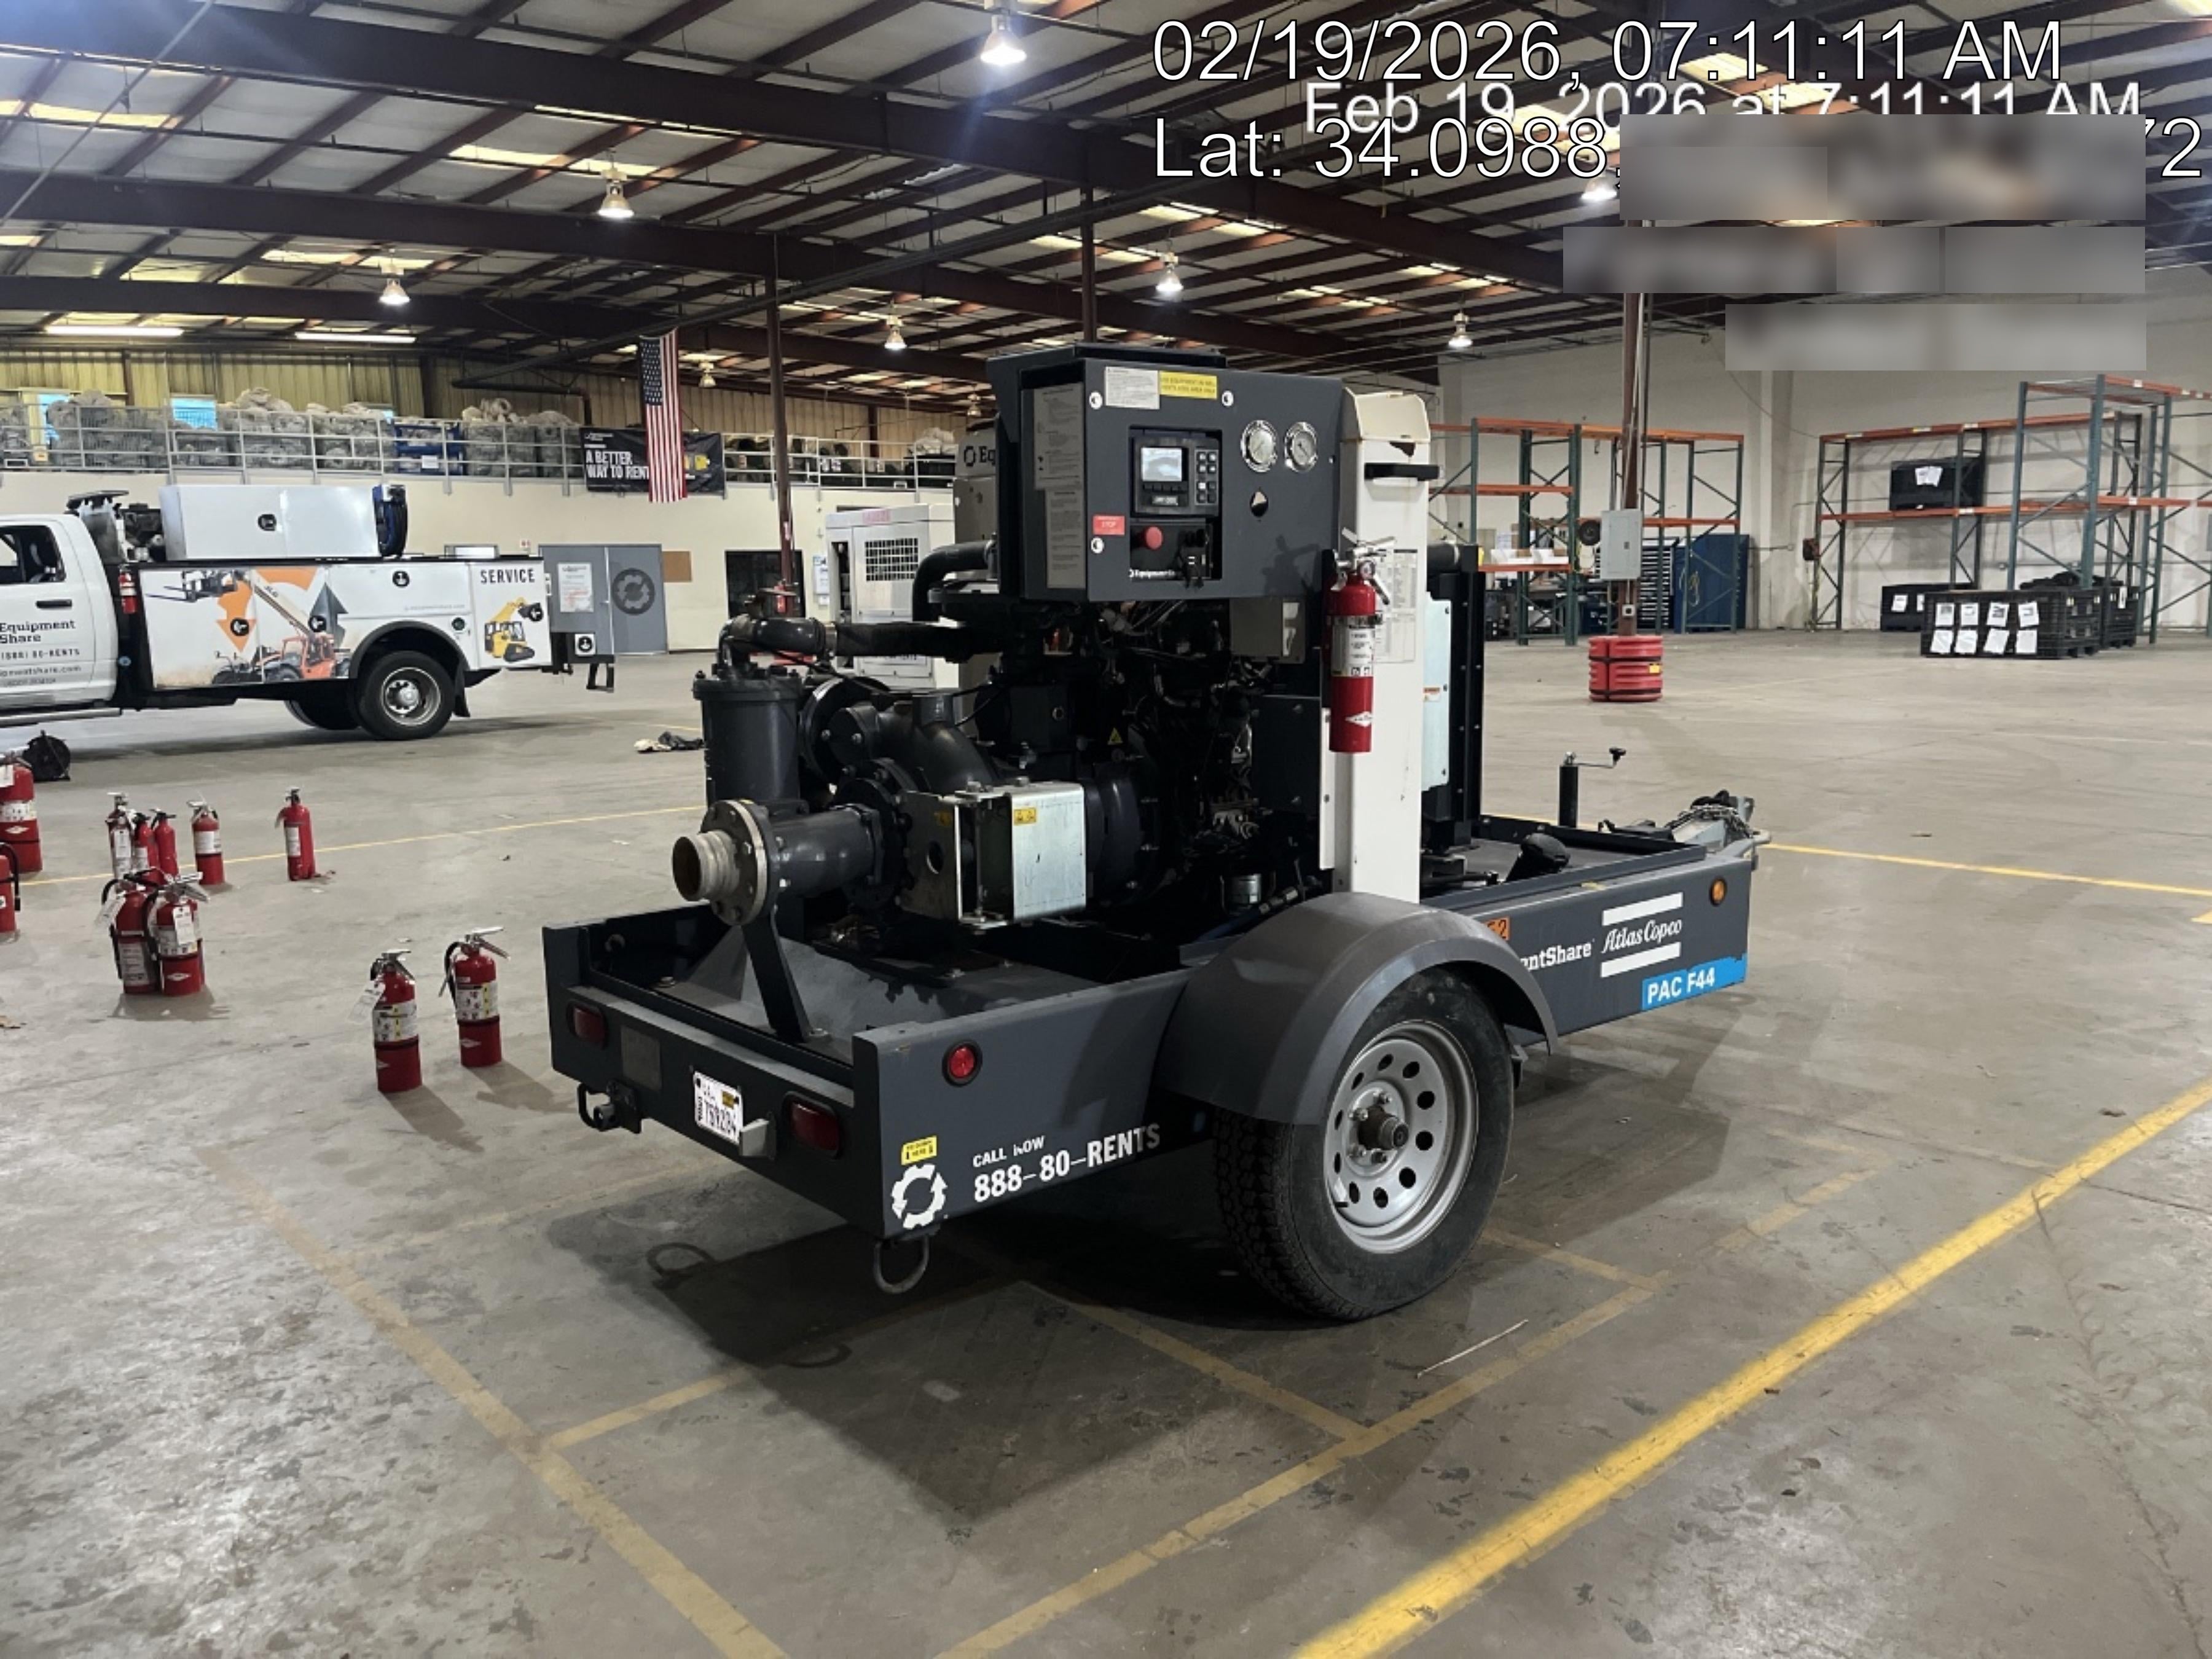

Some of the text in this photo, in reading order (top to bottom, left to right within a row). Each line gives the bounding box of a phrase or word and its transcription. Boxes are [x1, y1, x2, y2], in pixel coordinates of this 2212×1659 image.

[586, 450, 632, 465] A BETTER
[586, 465, 608, 478] WAY
[610, 465, 624, 479] TO
[480, 568, 535, 584] SERVICE
[0, 620, 76, 633] Equipment
[0, 633, 41, 644] Share
[1601, 919, 1682, 954] Atlas Copco
[1647, 967, 1716, 1004] PAC F44
[973, 1148, 1007, 1167] CALL
